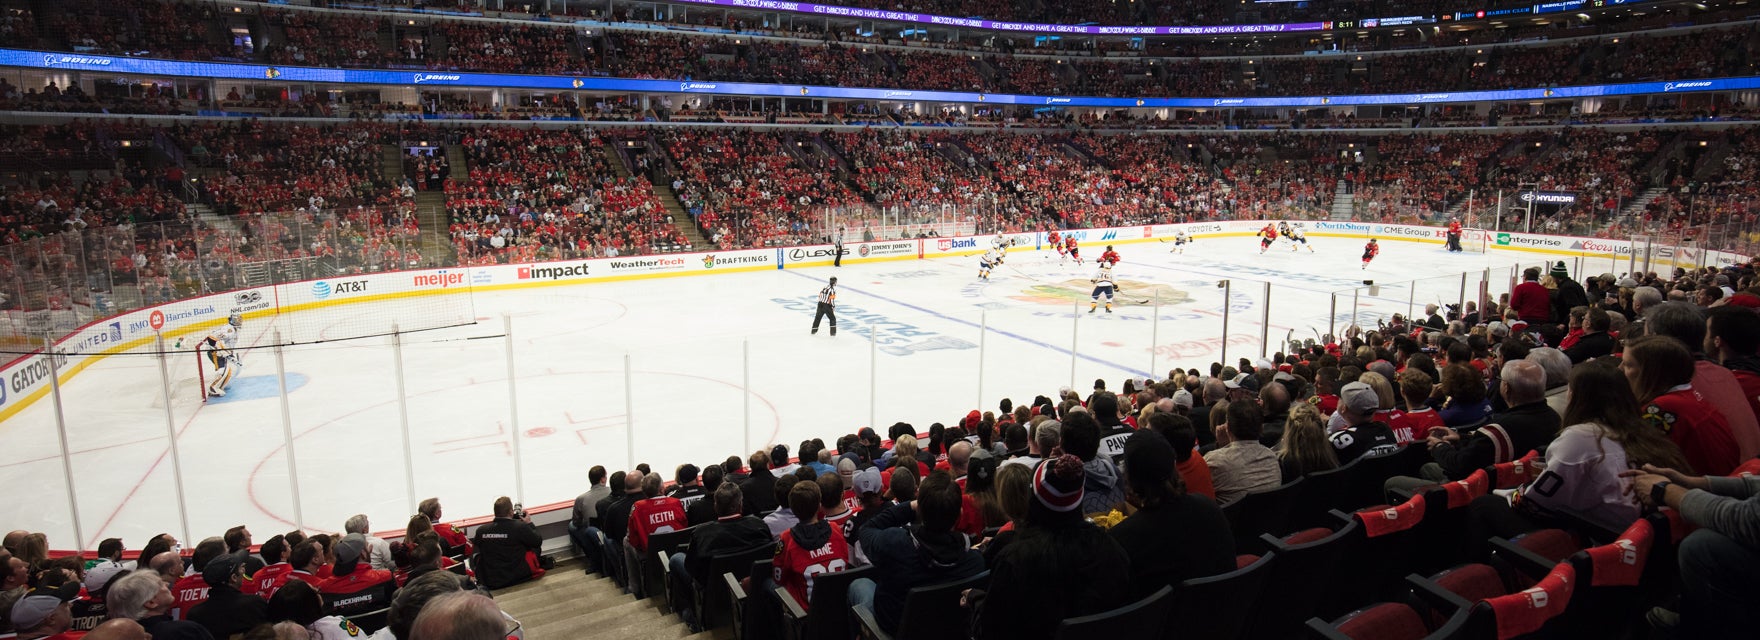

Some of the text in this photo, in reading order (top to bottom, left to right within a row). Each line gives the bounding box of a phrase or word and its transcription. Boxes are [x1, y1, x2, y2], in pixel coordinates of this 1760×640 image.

[61, 57, 111, 65] BOEING
[1536, 195, 1574, 203] HYUNDAI
[1188, 225, 1212, 233] COYOTE
[1321, 222, 1371, 231] NorthShore
[1384, 227, 1431, 237] CME Group
[1436, 230, 1493, 242] HNDA
[1582, 240, 1612, 252] Coors
[611, 258, 685, 269] WeatherTech
[716, 255, 768, 265] DRAFTKINGS
[531, 262, 589, 280] impact
[414, 270, 464, 288] meijer
[335, 280, 369, 294] AT&T
[230, 303, 270, 314] NHL.com/100
[129, 305, 216, 334] BMO Harris Bank
[73, 332, 109, 355] UNITED
[11, 347, 68, 394] GATORDE
[1393, 427, 1415, 443] KANE
[649, 510, 675, 525] KEITH
[810, 542, 834, 559] KANE
[333, 594, 373, 607] BLACKHAWKS
